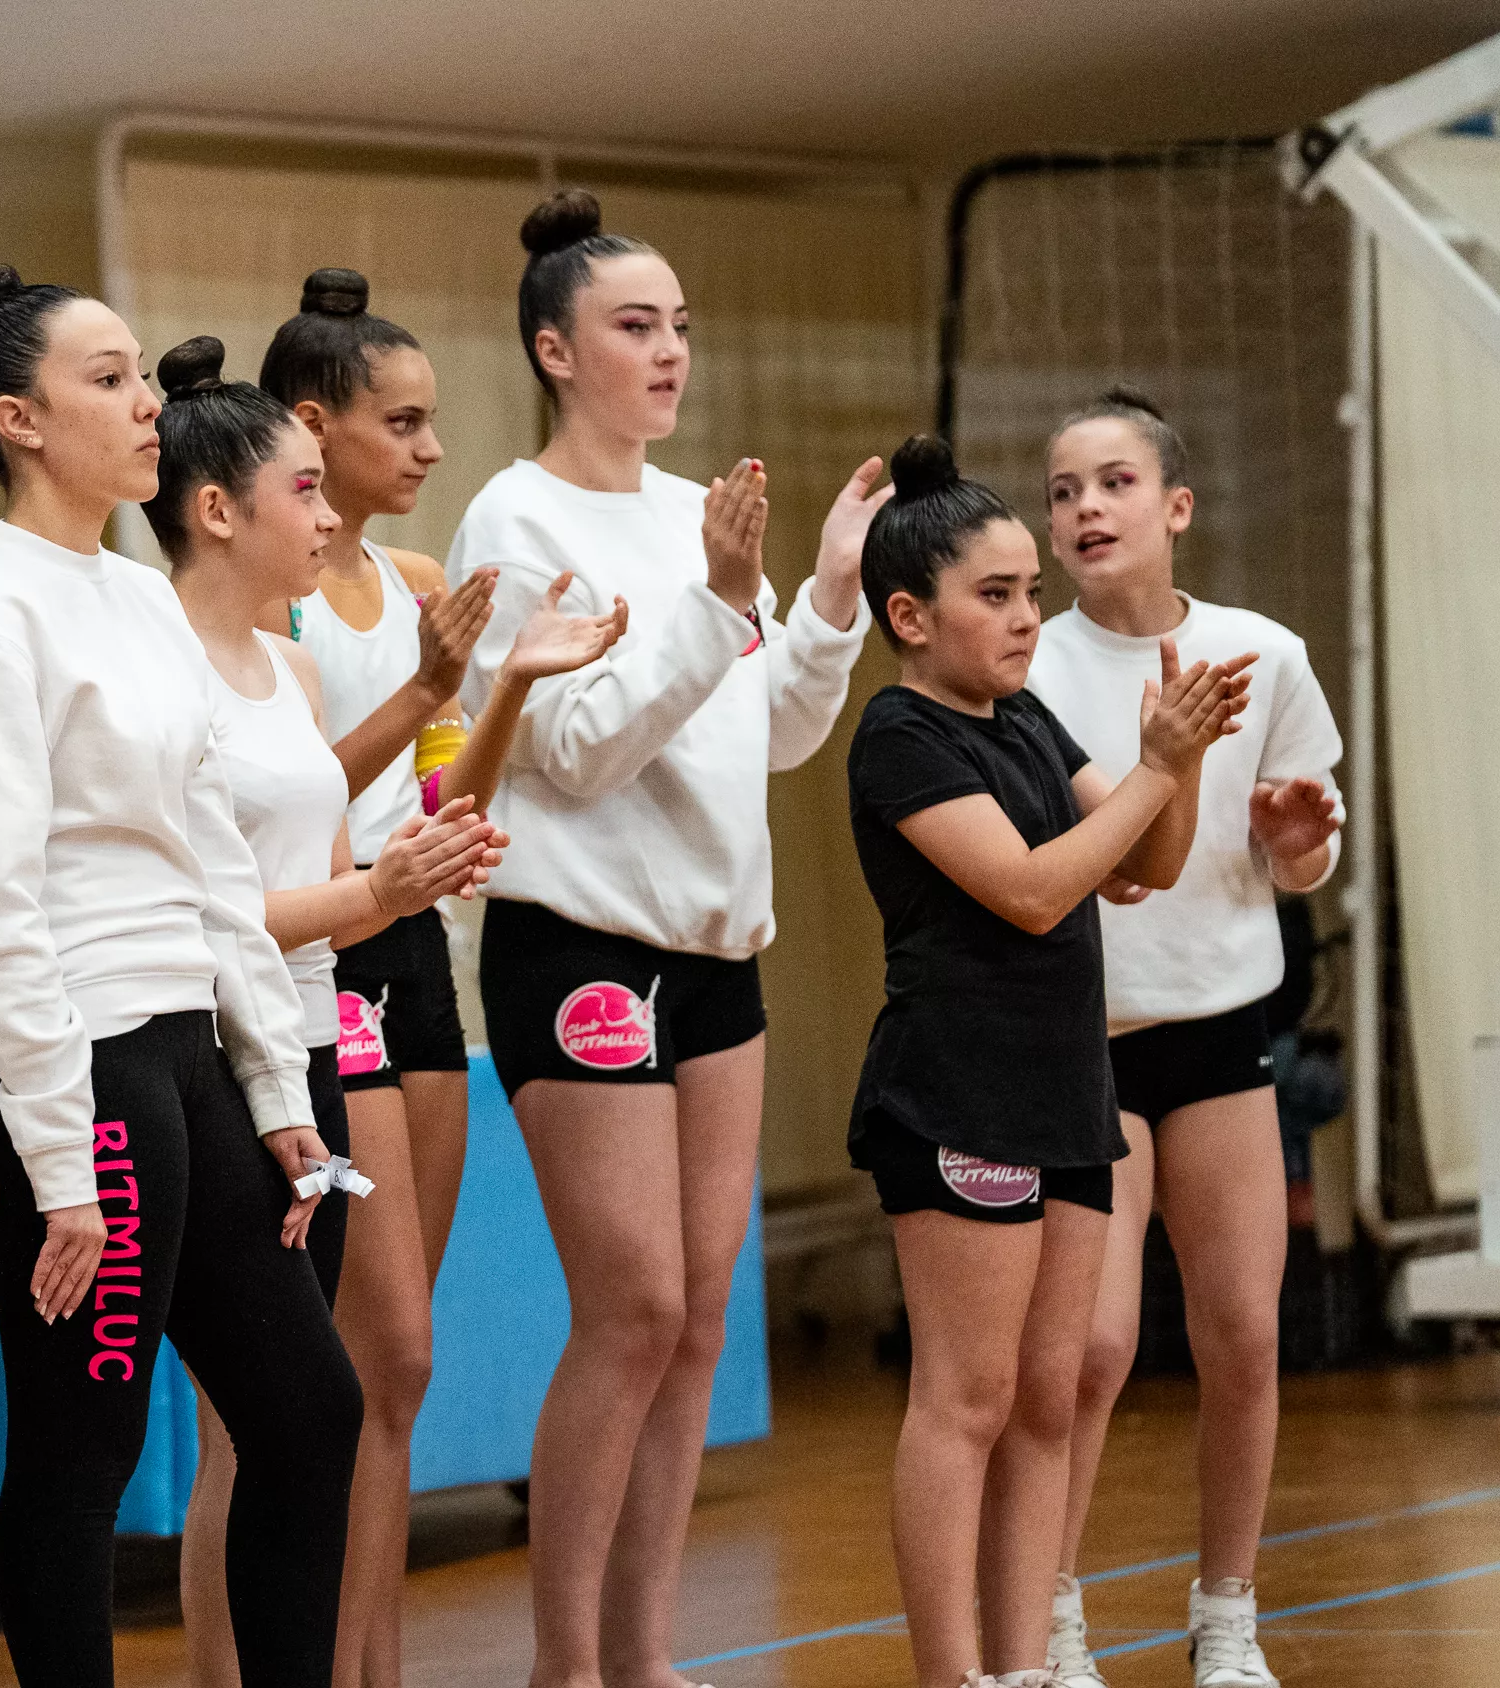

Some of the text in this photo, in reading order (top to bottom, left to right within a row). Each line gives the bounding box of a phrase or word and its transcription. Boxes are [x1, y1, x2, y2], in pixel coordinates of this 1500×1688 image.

[565, 1018, 601, 1039] Club
[568, 1032, 650, 1052] RITMILUC
[948, 1165, 1038, 1183] RITMILUC
[88, 1120, 142, 1381] RITMILUC
